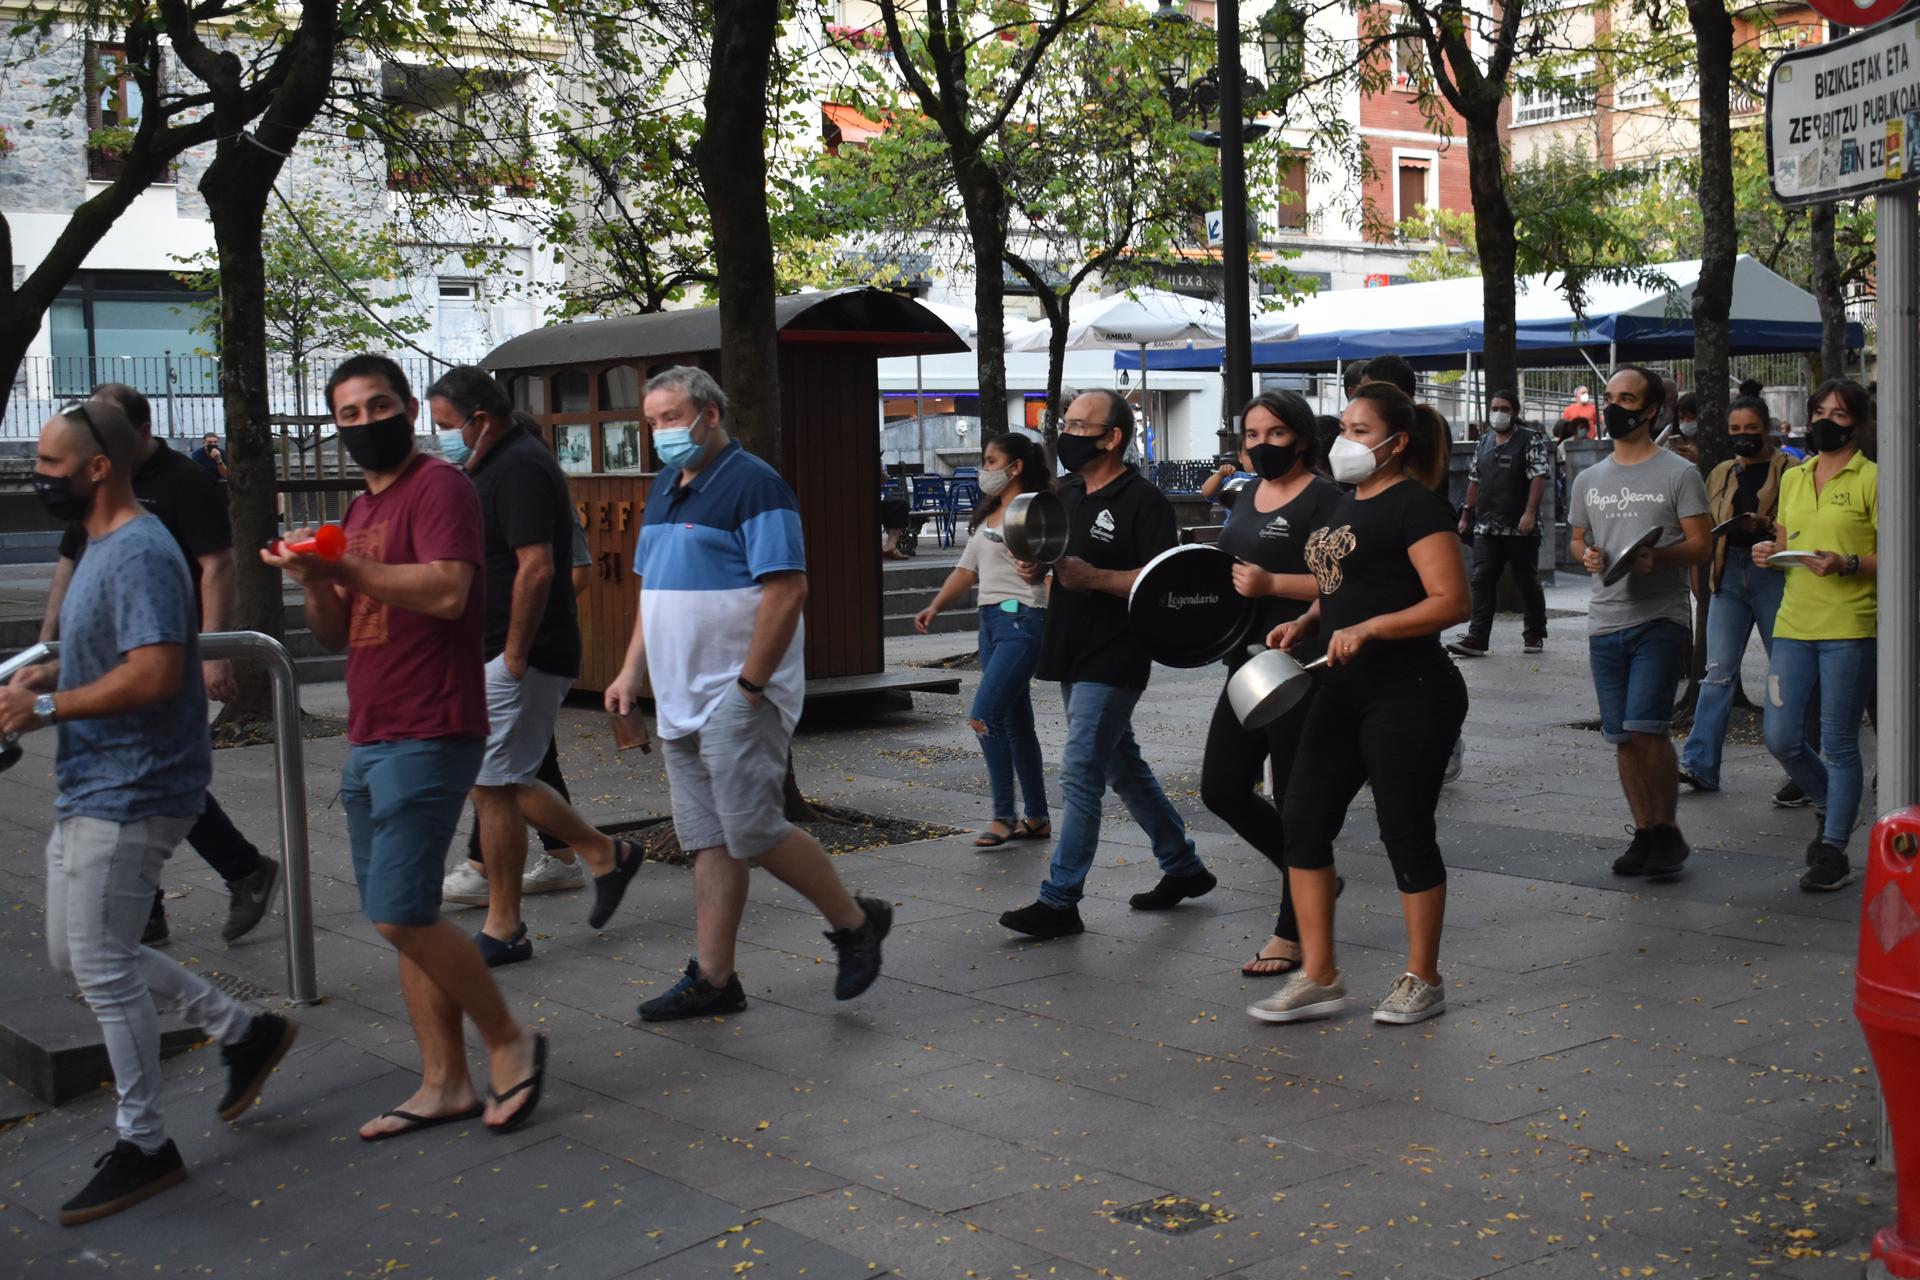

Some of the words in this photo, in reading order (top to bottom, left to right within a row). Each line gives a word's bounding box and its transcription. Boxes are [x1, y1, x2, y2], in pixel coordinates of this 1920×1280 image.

[1815, 52, 1882, 100] BIZIKLETAK
[1887, 42, 1909, 77] ETA
[1789, 103, 1858, 145] ZERBITZU
[1105, 333, 1132, 341] AMBAR
[1587, 488, 1618, 511] Pepe
[1617, 487, 1666, 510] Jeans
[1167, 591, 1219, 610] Legendario
